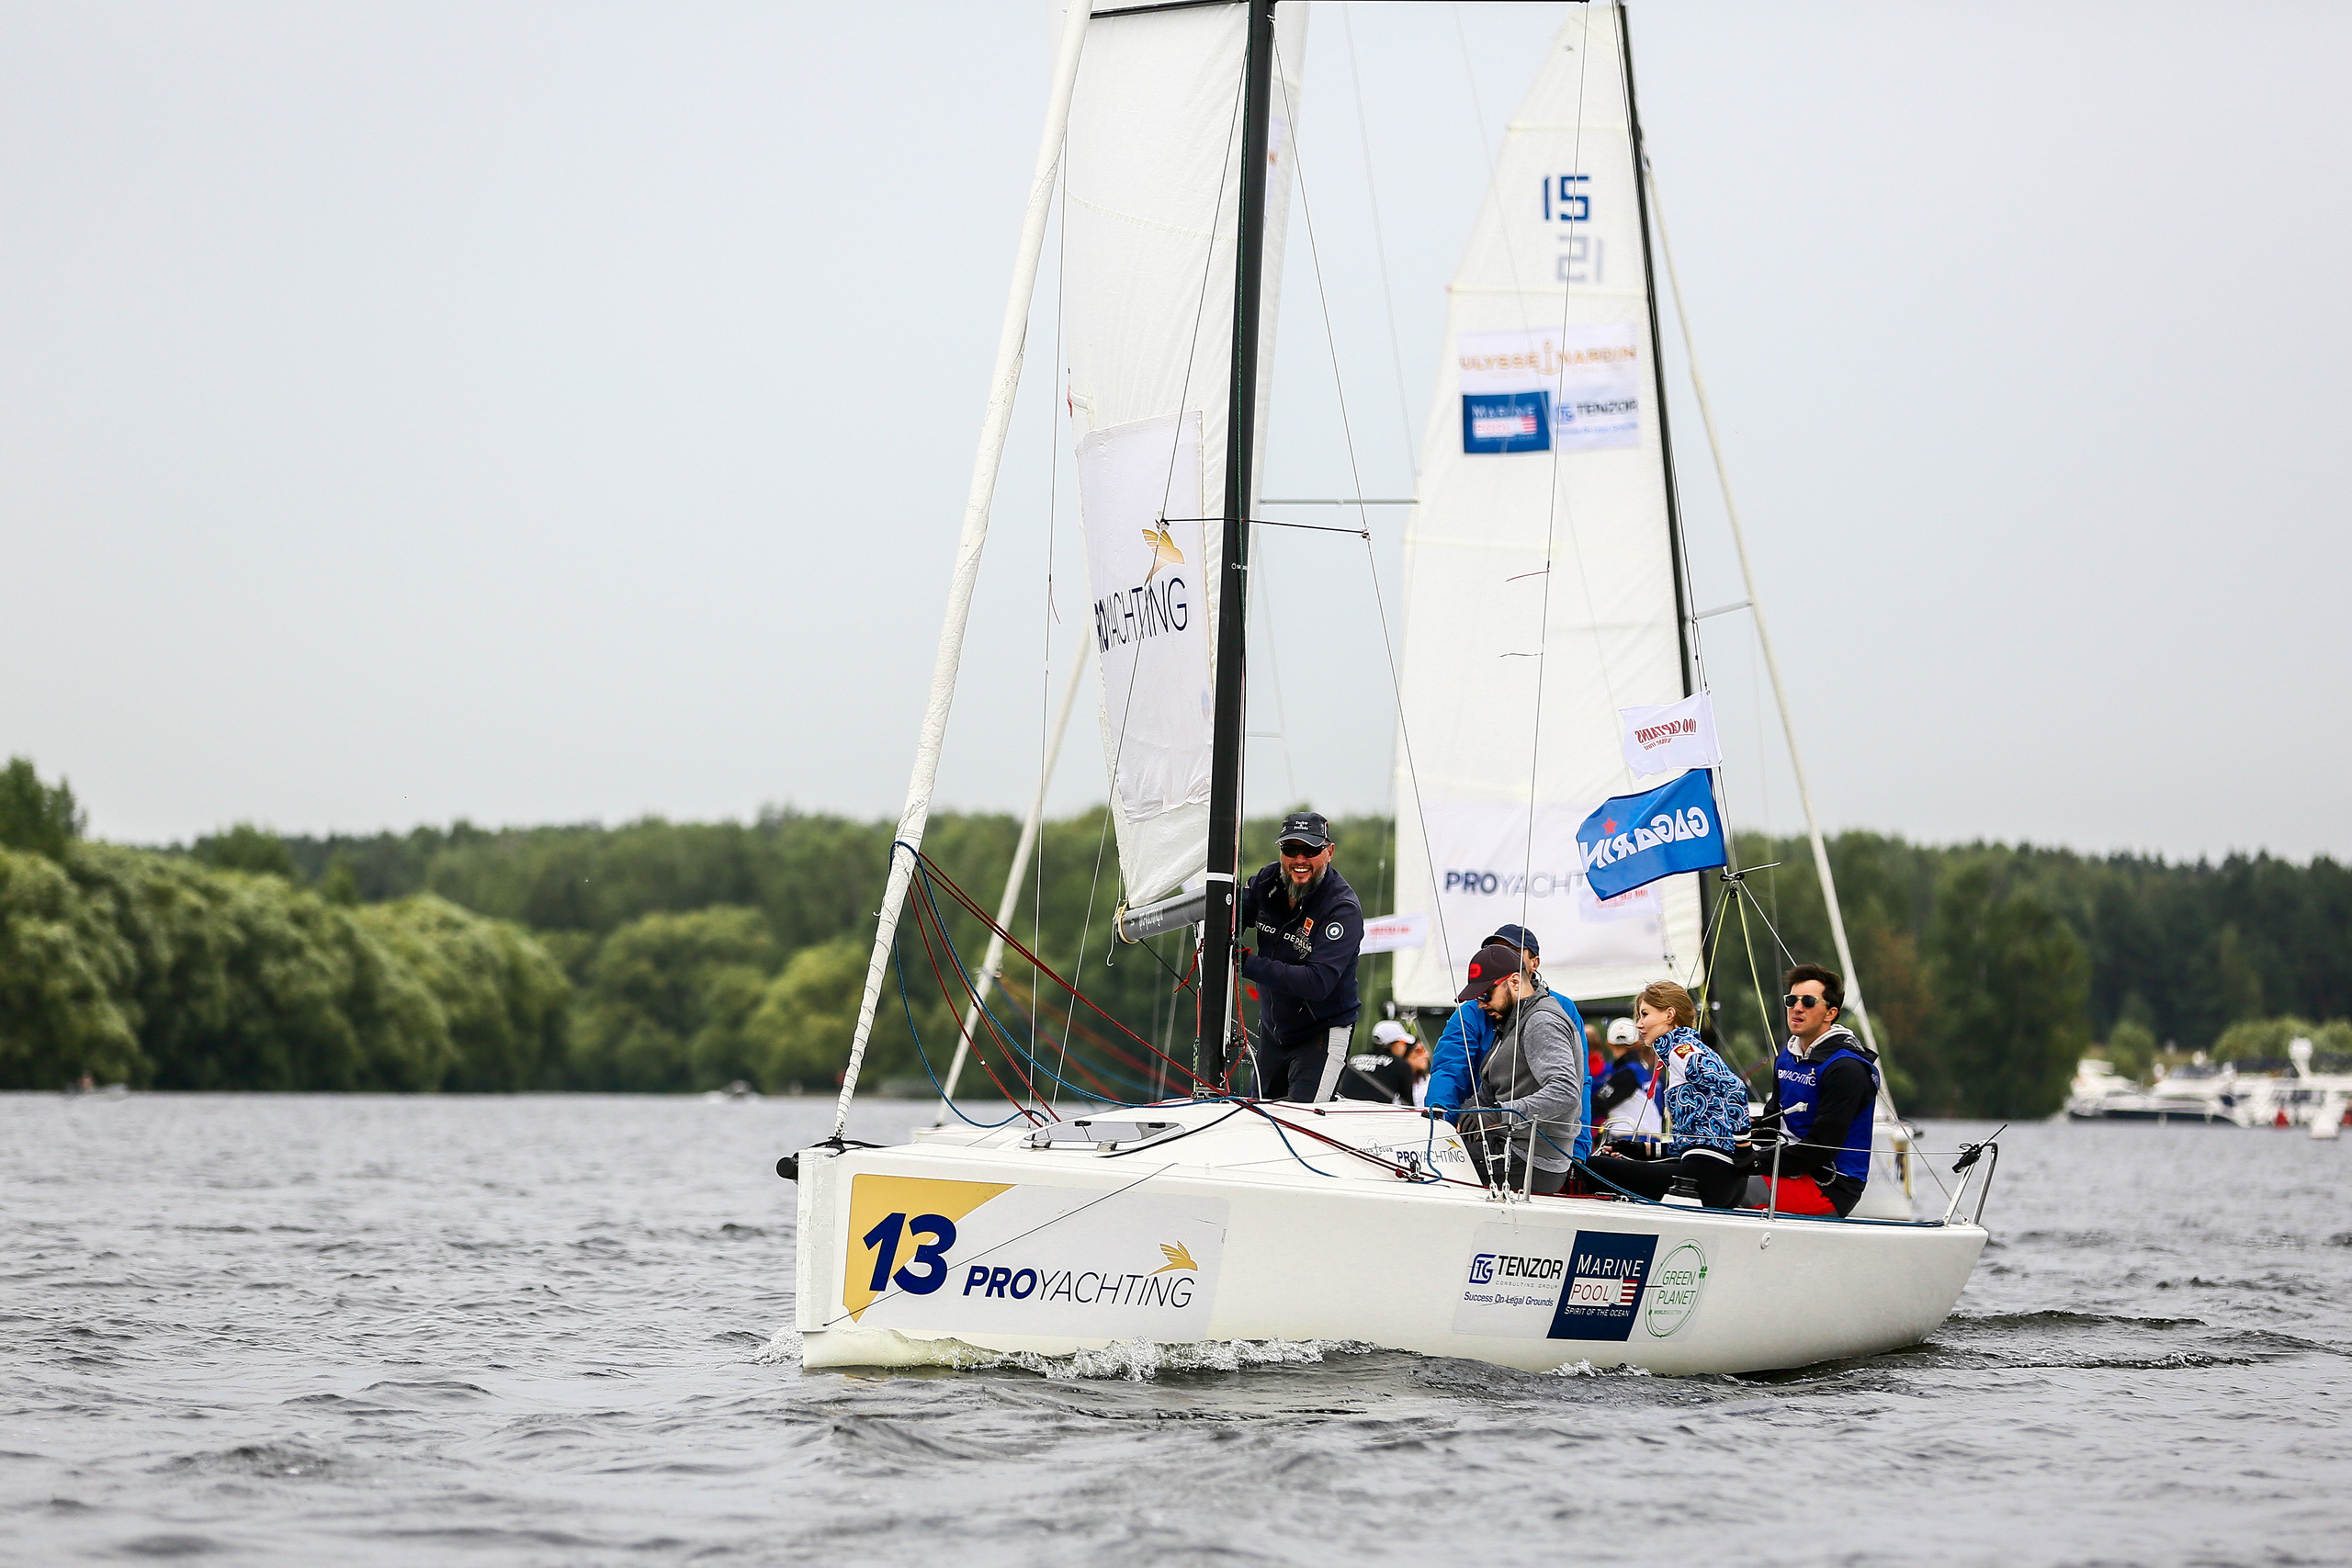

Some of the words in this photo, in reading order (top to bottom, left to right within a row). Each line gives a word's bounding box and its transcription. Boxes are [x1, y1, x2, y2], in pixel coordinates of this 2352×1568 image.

[1544, 175, 1590, 221] 15
[1459, 351, 1539, 370] ULYSSE
[1557, 344, 1638, 366] NARDIN
[1445, 870, 1585, 898] PROYACHT
[862, 1212, 957, 1295] 13
[1497, 1254, 1564, 1280] TENZOR
[1576, 1254, 1645, 1278] MARINE
[1663, 1270, 1697, 1286] GREEN
[963, 1264, 1196, 1308] PROYACHTING
[1495, 1280, 1535, 1289] CONSULTING
[1570, 1283, 1610, 1303] POOL
[1464, 1291, 1494, 1303] Success
[1495, 1293, 1505, 1303] On
[1506, 1294, 1524, 1307] Legal
[1525, 1295, 1555, 1307] Grounds
[1657, 1290, 1697, 1305] PLANET
[1564, 1305, 1585, 1315] SPIRIT
[1586, 1307, 1595, 1315] OF
[1597, 1307, 1609, 1316] THE
[1610, 1308, 1631, 1317] OCEAN
